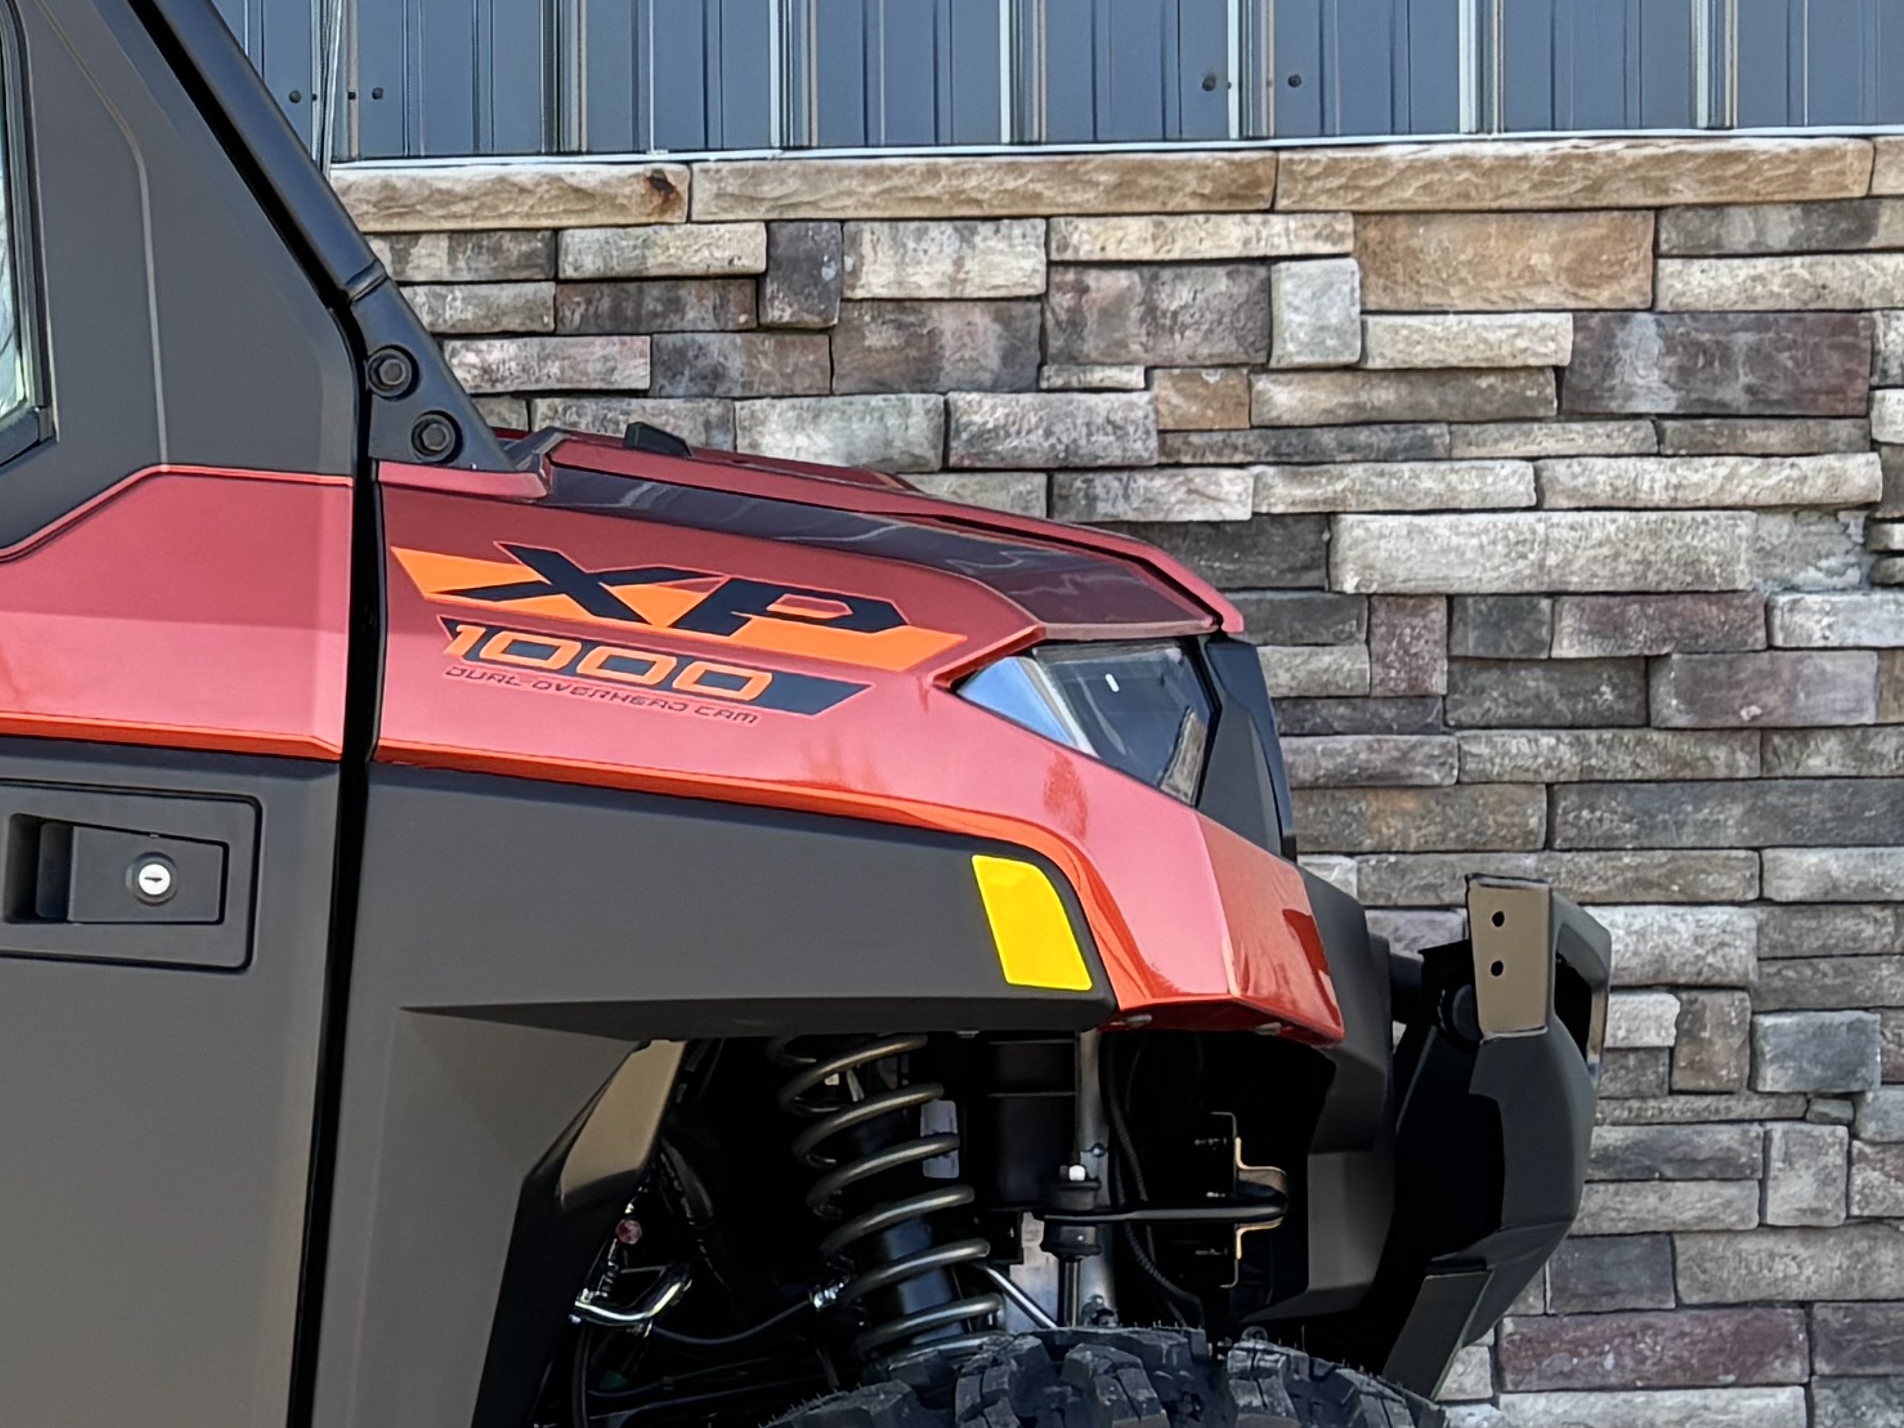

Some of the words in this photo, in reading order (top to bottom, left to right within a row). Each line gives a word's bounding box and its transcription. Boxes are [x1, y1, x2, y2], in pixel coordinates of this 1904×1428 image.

[433, 542, 912, 637] XP
[442, 624, 774, 702] 1000
[445, 666, 523, 687] DUAL
[531, 679, 690, 712] OVERHEAD
[693, 705, 759, 724] CAM
